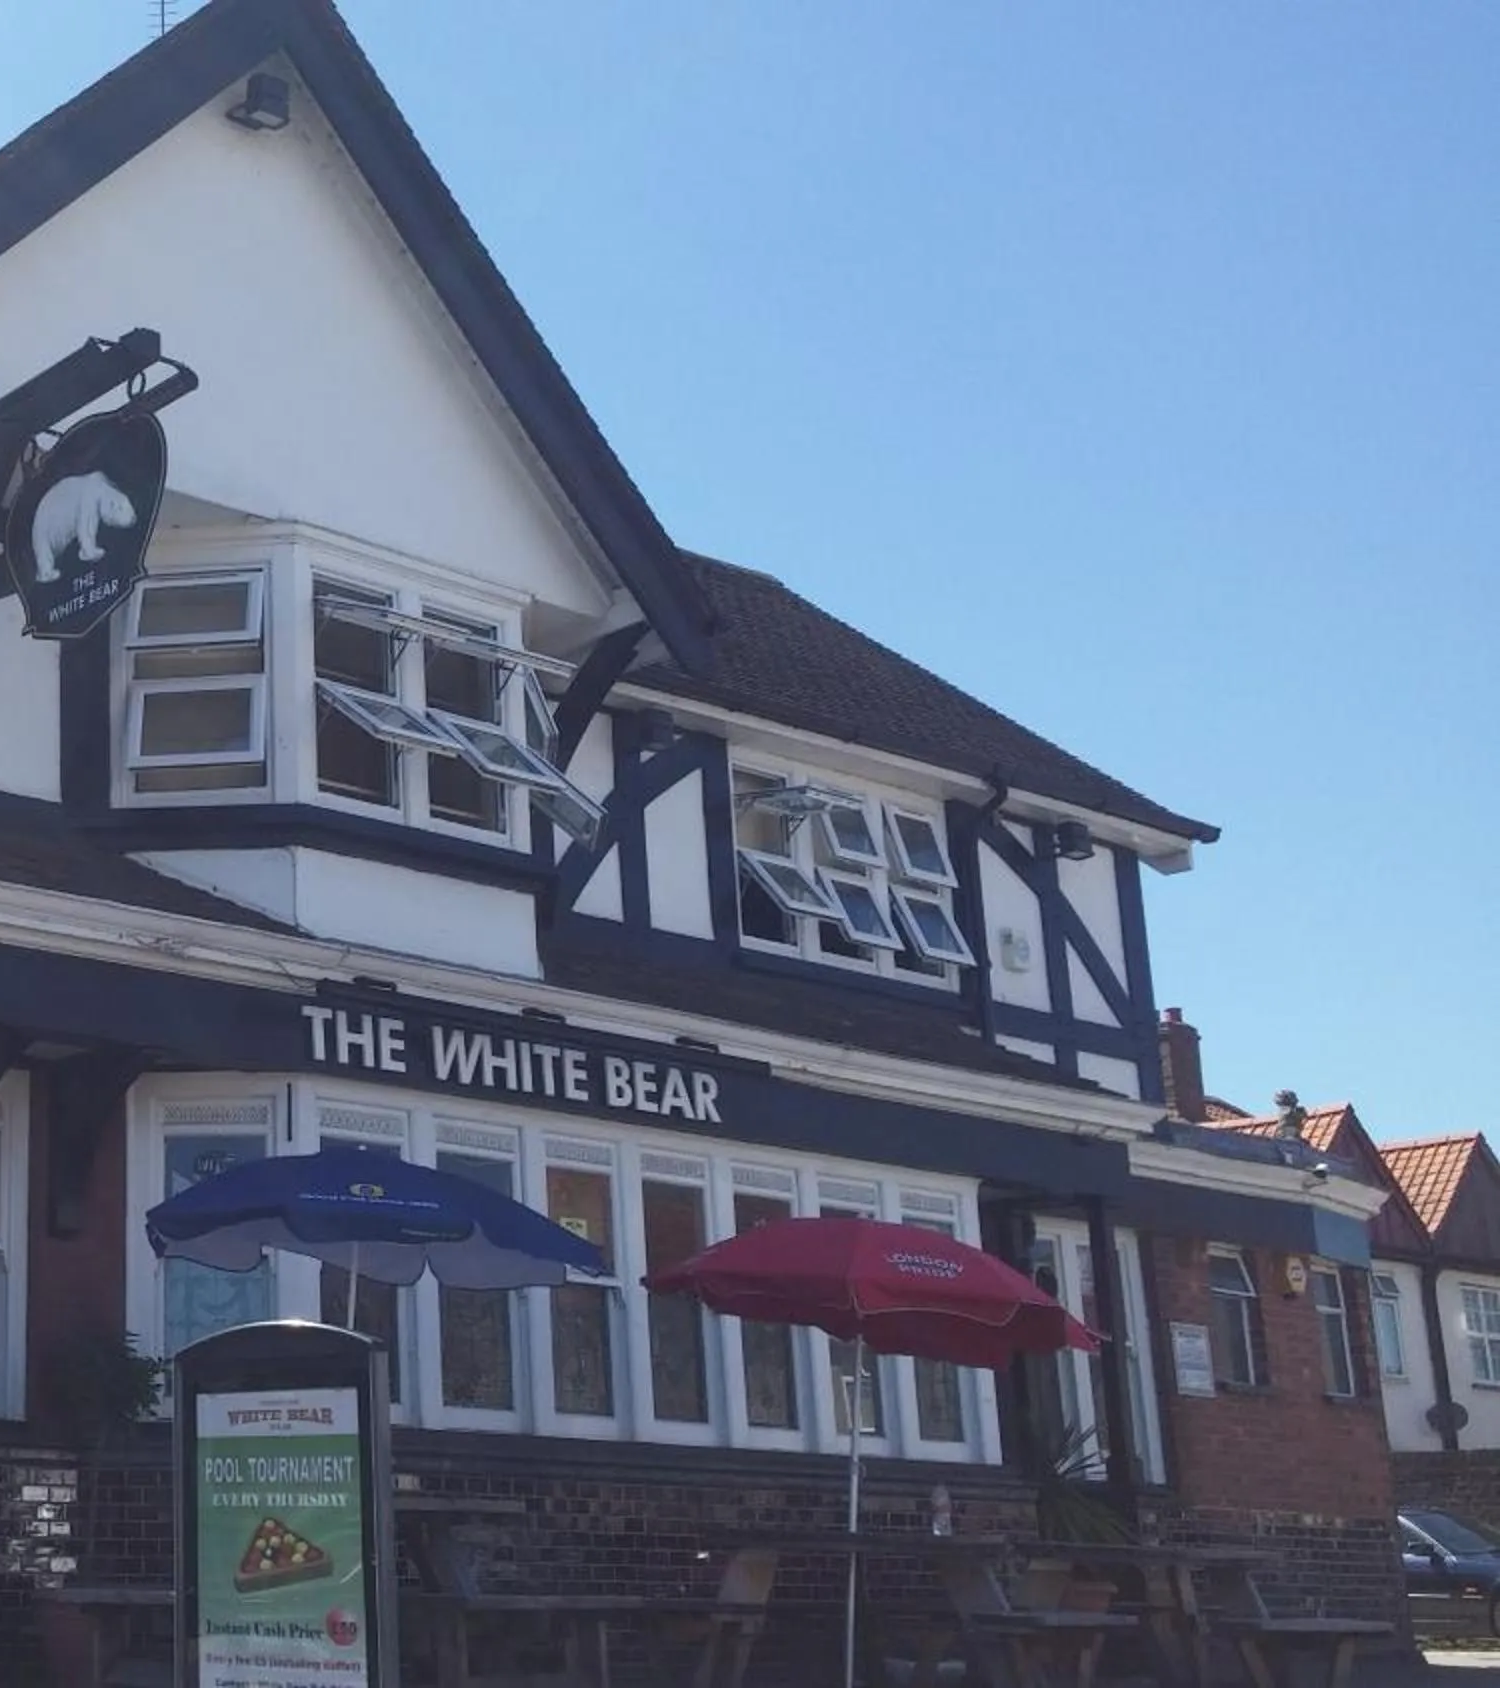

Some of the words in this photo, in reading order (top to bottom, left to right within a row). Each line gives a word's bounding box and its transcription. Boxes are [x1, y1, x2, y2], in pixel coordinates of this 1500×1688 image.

[73, 571, 96, 592] THE
[49, 593, 85, 622] WHITE
[88, 579, 119, 605] BEAR
[302, 1005, 406, 1073] THE
[431, 1025, 589, 1101] WHITE
[604, 1056, 722, 1122] BEAR
[884, 1252, 964, 1273] LONDON
[227, 1409, 281, 1425] WHITE
[286, 1407, 334, 1425] BEAR
[204, 1457, 244, 1483] POOL
[248, 1455, 354, 1485] TOURNAMENT
[212, 1494, 260, 1507] EVERY
[266, 1493, 350, 1507] THURSDAY
